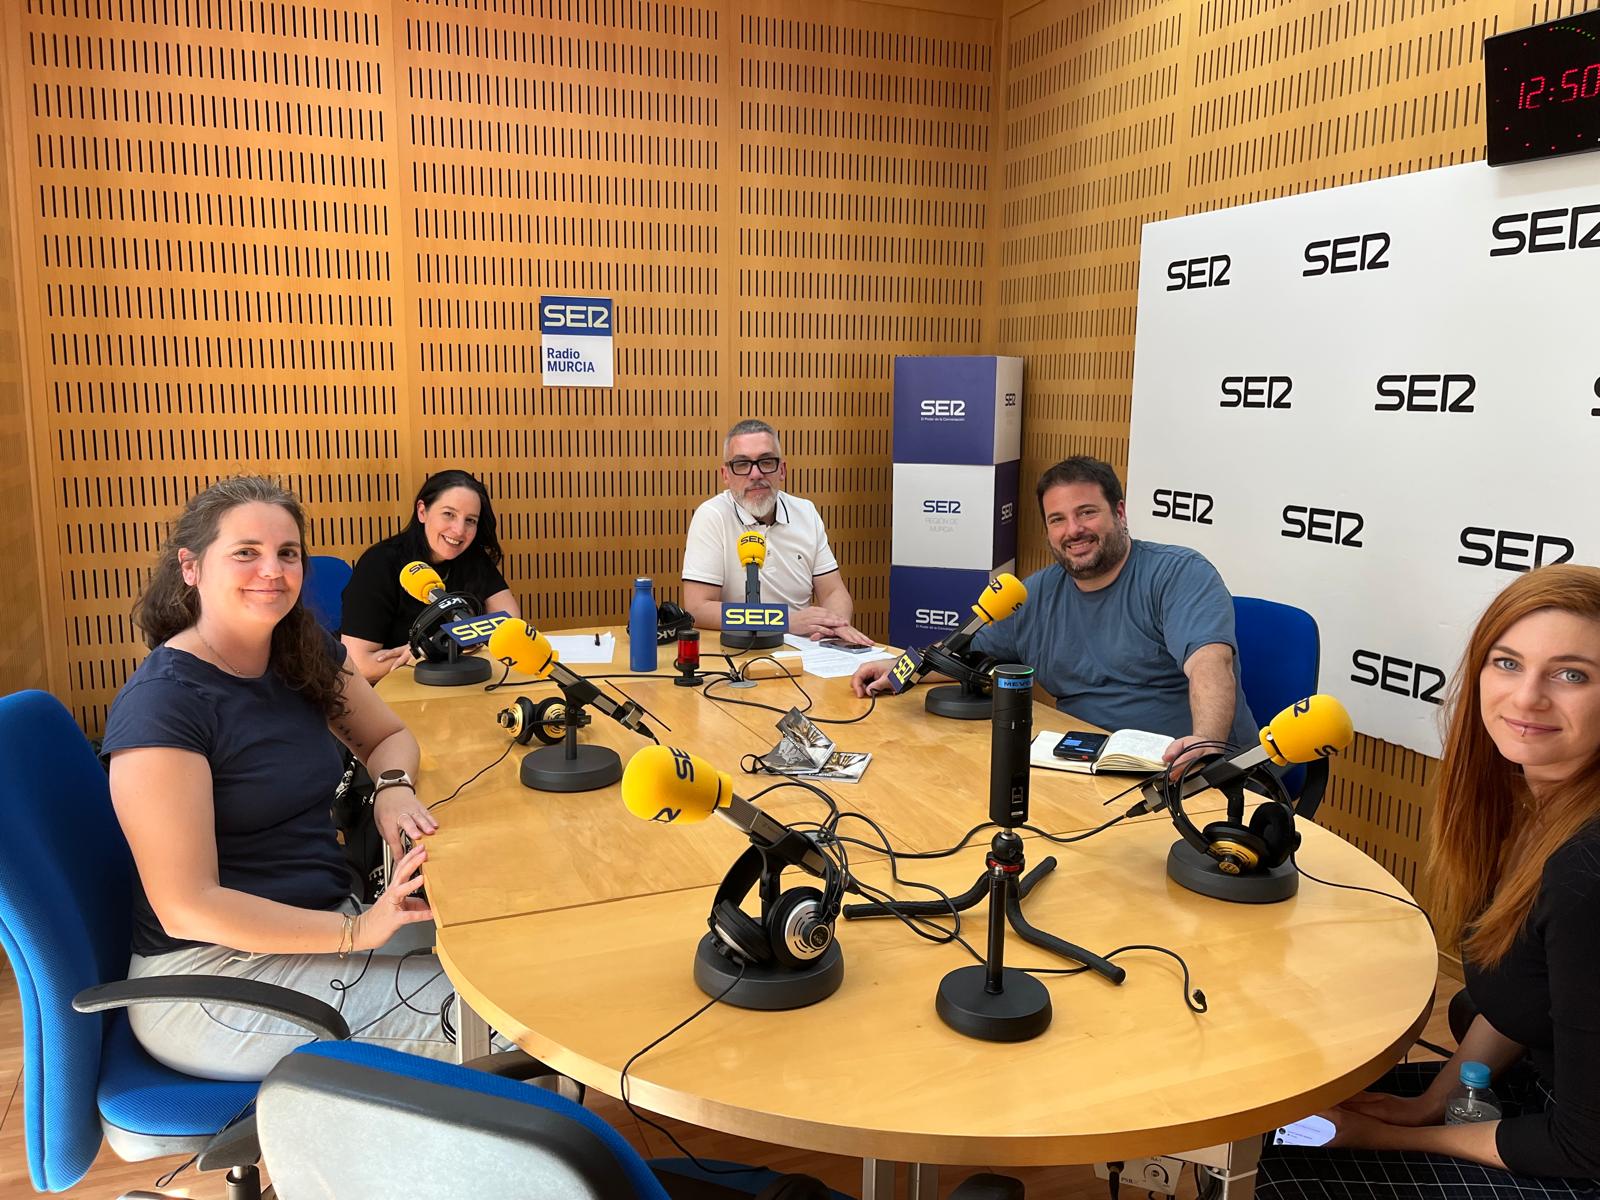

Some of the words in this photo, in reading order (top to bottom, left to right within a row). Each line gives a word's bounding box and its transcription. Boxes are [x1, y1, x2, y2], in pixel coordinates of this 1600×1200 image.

[1518, 64, 1600, 110] 12:50
[1490, 204, 1600, 257] SER
[1302, 232, 1391, 277] SER
[1166, 254, 1231, 291] SER
[543, 304, 610, 329] SER
[546, 347, 580, 360] Radio
[547, 360, 595, 373] MURCIA
[920, 400, 966, 416] SER
[1219, 375, 1293, 409] SER
[1375, 374, 1477, 413] SER
[923, 500, 961, 514] SER
[1152, 488, 1214, 525] SER
[740, 535, 765, 547] SER
[1281, 504, 1364, 548] SER
[1458, 526, 1575, 573] SER
[409, 563, 431, 576] SE
[725, 608, 785, 626] SER
[915, 608, 960, 627] SER
[1350, 649, 1446, 706] SER
[668, 745, 695, 783] SE
